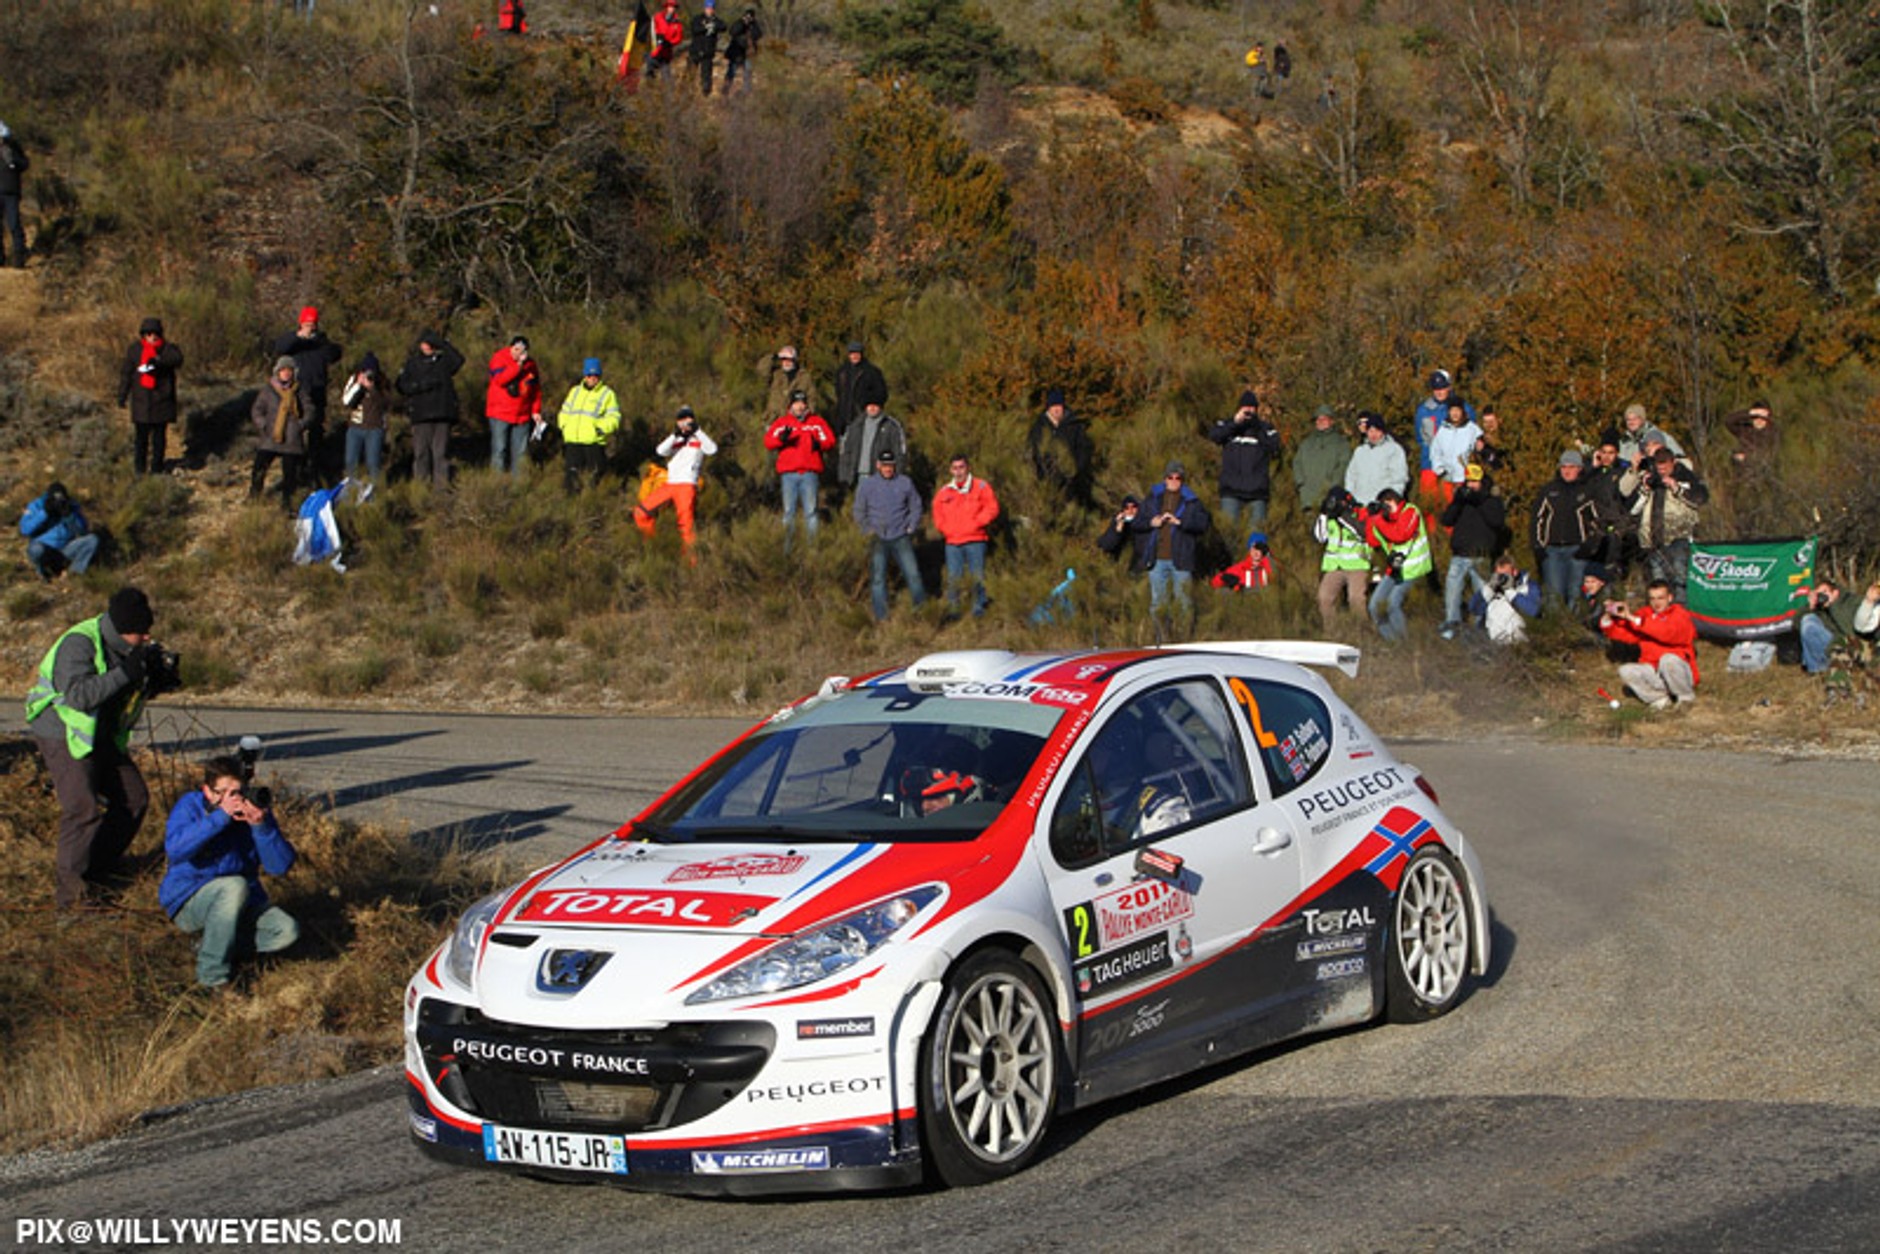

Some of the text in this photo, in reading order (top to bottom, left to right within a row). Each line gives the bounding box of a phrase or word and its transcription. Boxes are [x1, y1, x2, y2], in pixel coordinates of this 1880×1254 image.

[1228, 677, 1279, 749] 2
[1297, 767, 1404, 820] PEUGEOT
[542, 890, 715, 923] TOTAL
[1117, 881, 1169, 910] 2011
[1073, 906, 1093, 957] 2
[1302, 906, 1376, 934] TOTAL
[799, 1021, 872, 1037] remember
[453, 1038, 650, 1075] PEUGEOT FRANCE
[747, 1076, 886, 1102] PEUGEOT
[722, 1150, 824, 1168] MICHELIN
